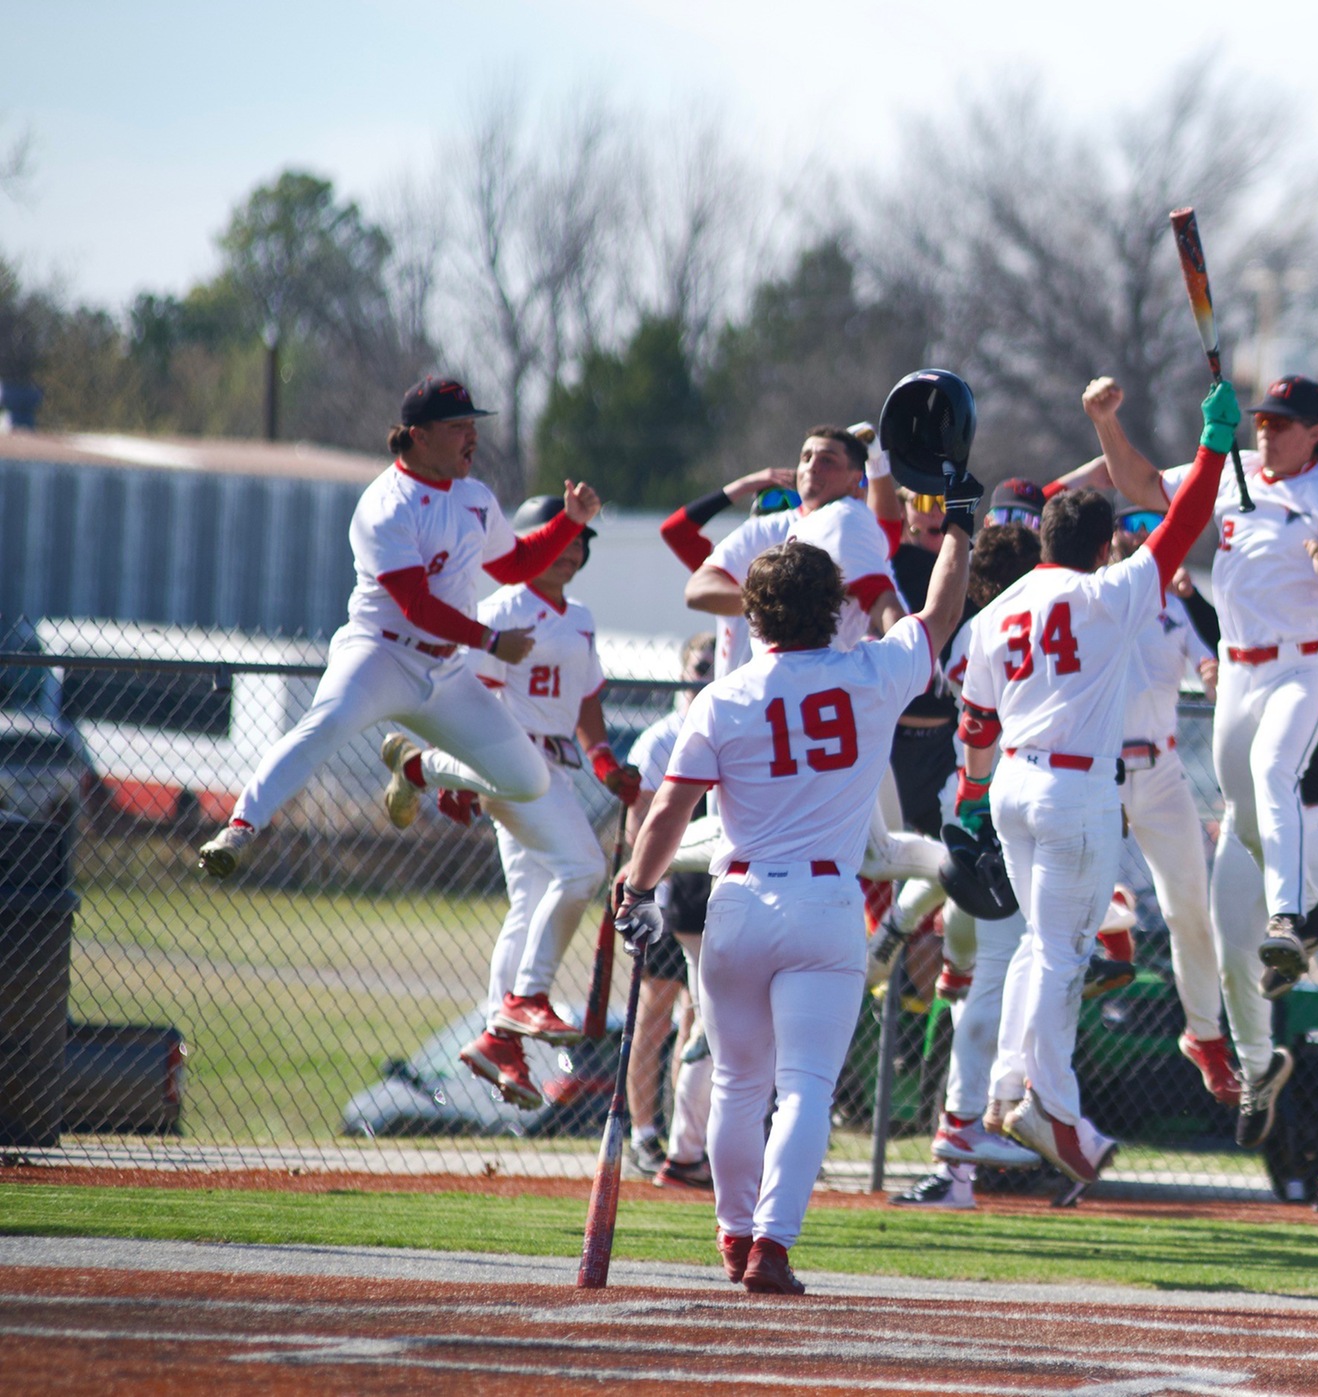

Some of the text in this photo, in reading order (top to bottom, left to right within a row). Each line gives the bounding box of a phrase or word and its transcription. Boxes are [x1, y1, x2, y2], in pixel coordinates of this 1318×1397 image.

[528, 664, 561, 698] 21
[1000, 601, 1082, 683] 34
[764, 686, 859, 778] 19
